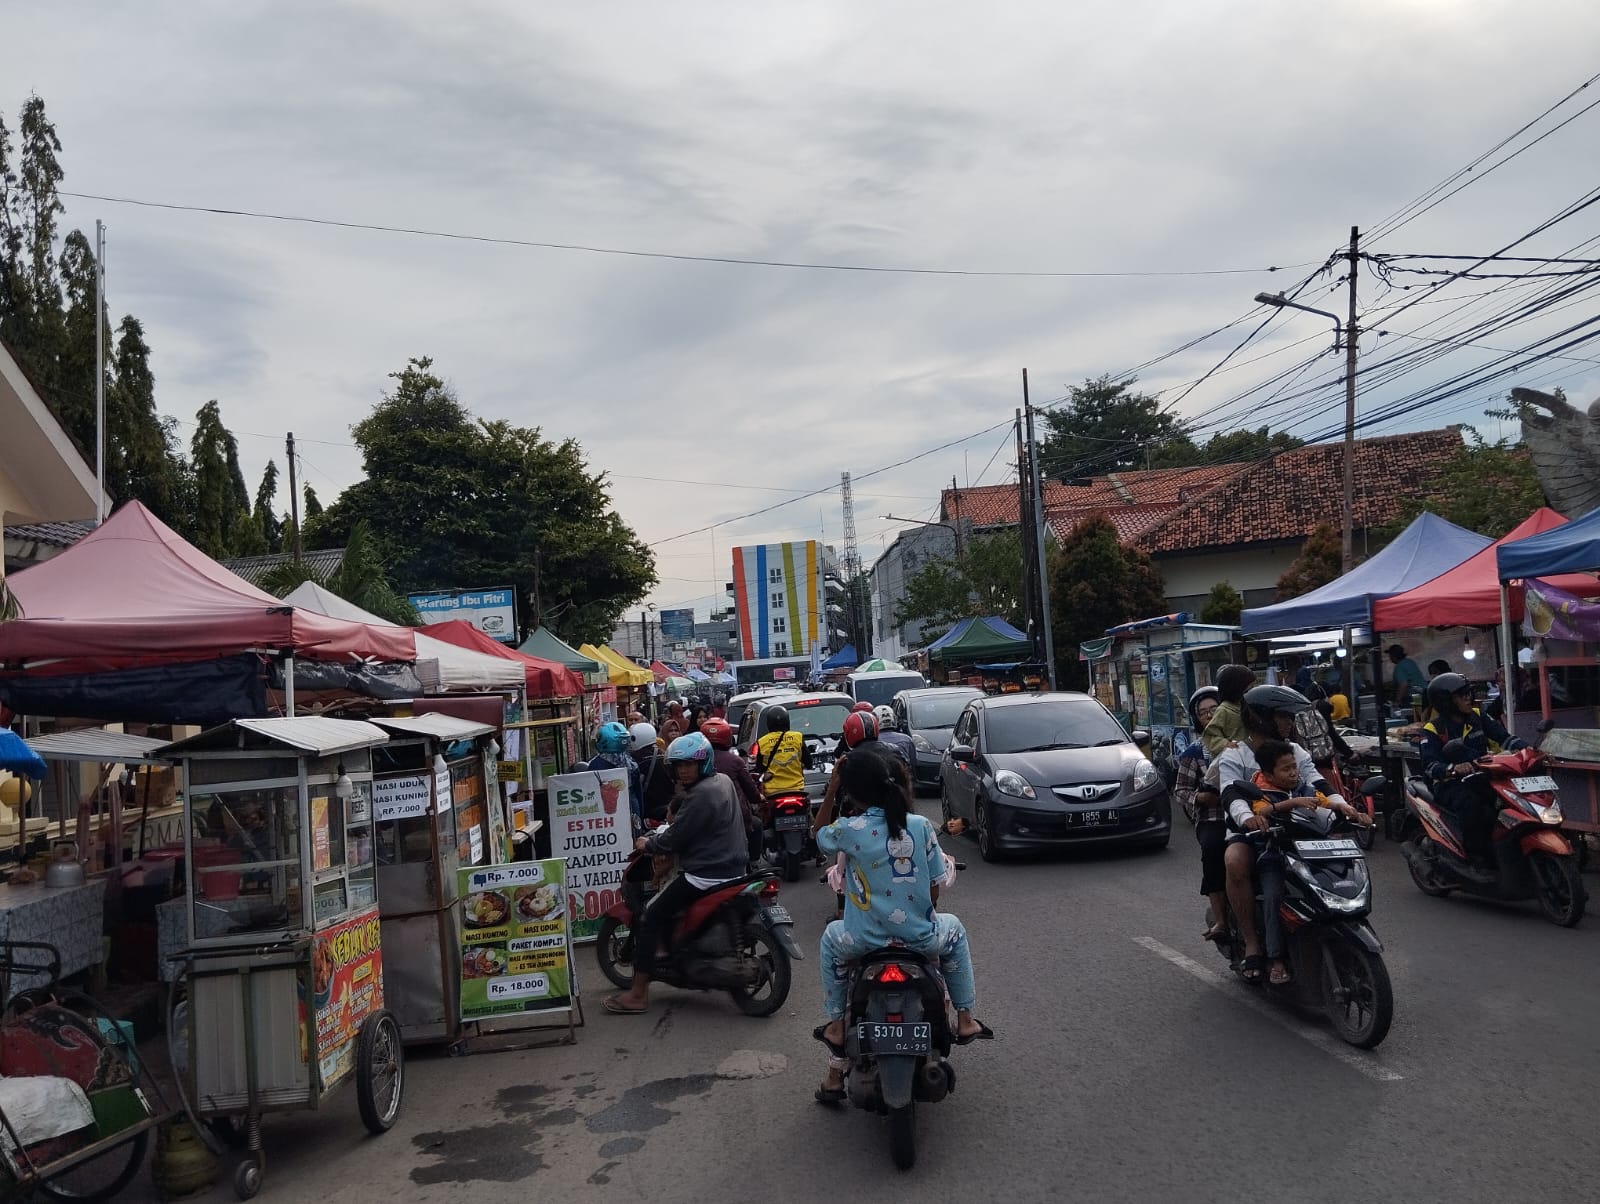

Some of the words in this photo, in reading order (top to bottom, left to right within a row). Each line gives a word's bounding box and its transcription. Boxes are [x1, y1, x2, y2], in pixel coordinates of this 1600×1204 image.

[417, 597, 459, 608] Warung
[462, 596, 480, 605] Ibu
[483, 593, 505, 604] Fitri
[376, 783, 397, 791] NASI
[400, 780, 426, 789] UDUK
[395, 791, 429, 802] KUNING
[557, 789, 584, 806] ES
[398, 804, 420, 813] 7.000
[1068, 813, 1073, 823] Z
[1081, 811, 1100, 821] 1855
[1108, 810, 1118, 820] AL
[567, 820, 584, 832] ES
[587, 816, 614, 829] TEH
[563, 832, 617, 851] JUMBO
[487, 872, 505, 882] Rp.
[508, 868, 538, 879] 7.000
[584, 870, 624, 887] VARIA
[540, 924, 559, 932] UDUK
[511, 941, 532, 950] PAKET
[533, 938, 563, 948] KOMPLIT
[491, 985, 507, 994] Rp.
[510, 979, 544, 990] 18.000
[859, 1026, 865, 1039] E
[874, 1025, 903, 1038] 5370
[913, 1025, 928, 1038] CZ
[896, 1043, 927, 1051] 04-25
